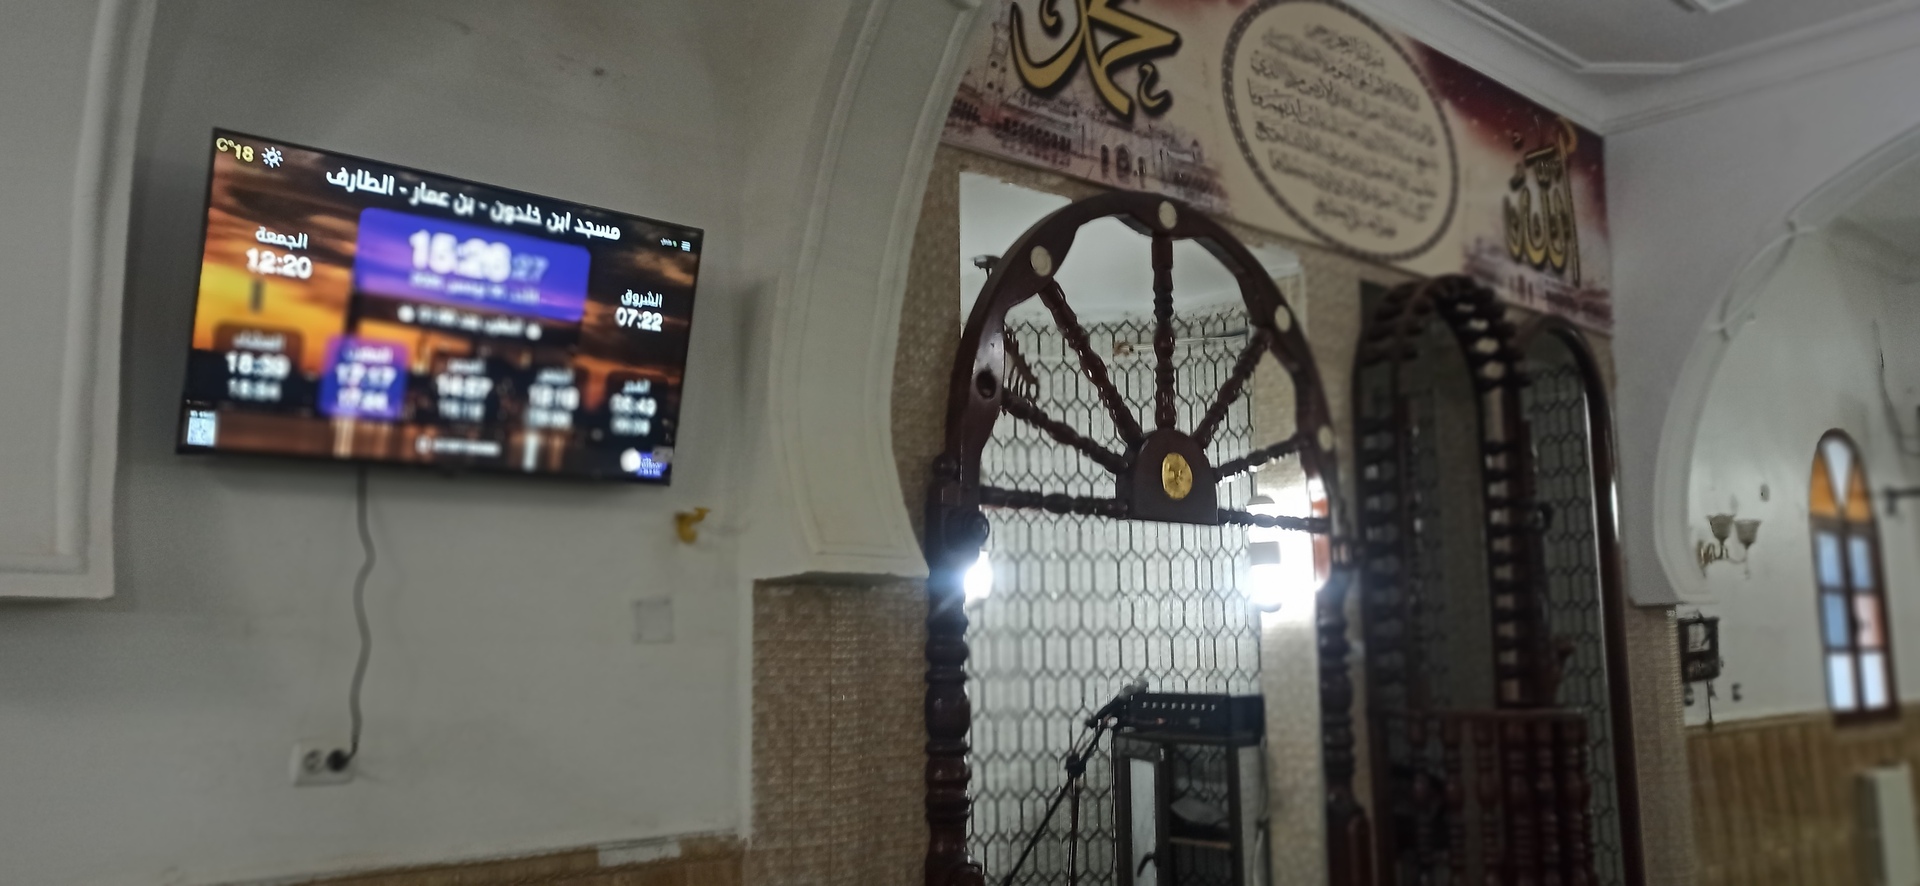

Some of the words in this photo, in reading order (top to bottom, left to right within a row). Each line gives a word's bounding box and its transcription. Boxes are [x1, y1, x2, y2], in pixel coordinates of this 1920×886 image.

[326, 166, 395, 196] الطارف
[409, 181, 450, 208] عمار
[453, 192, 474, 217] بن
[489, 200, 542, 226] خلدون
[547, 211, 571, 234] ابن
[255, 226, 308, 249] الجمعة
[574, 216, 621, 241] مسجد
[245, 247, 313, 280] 12:20
[621, 288, 663, 309] الشروق
[615, 306, 663, 332] 07:22
